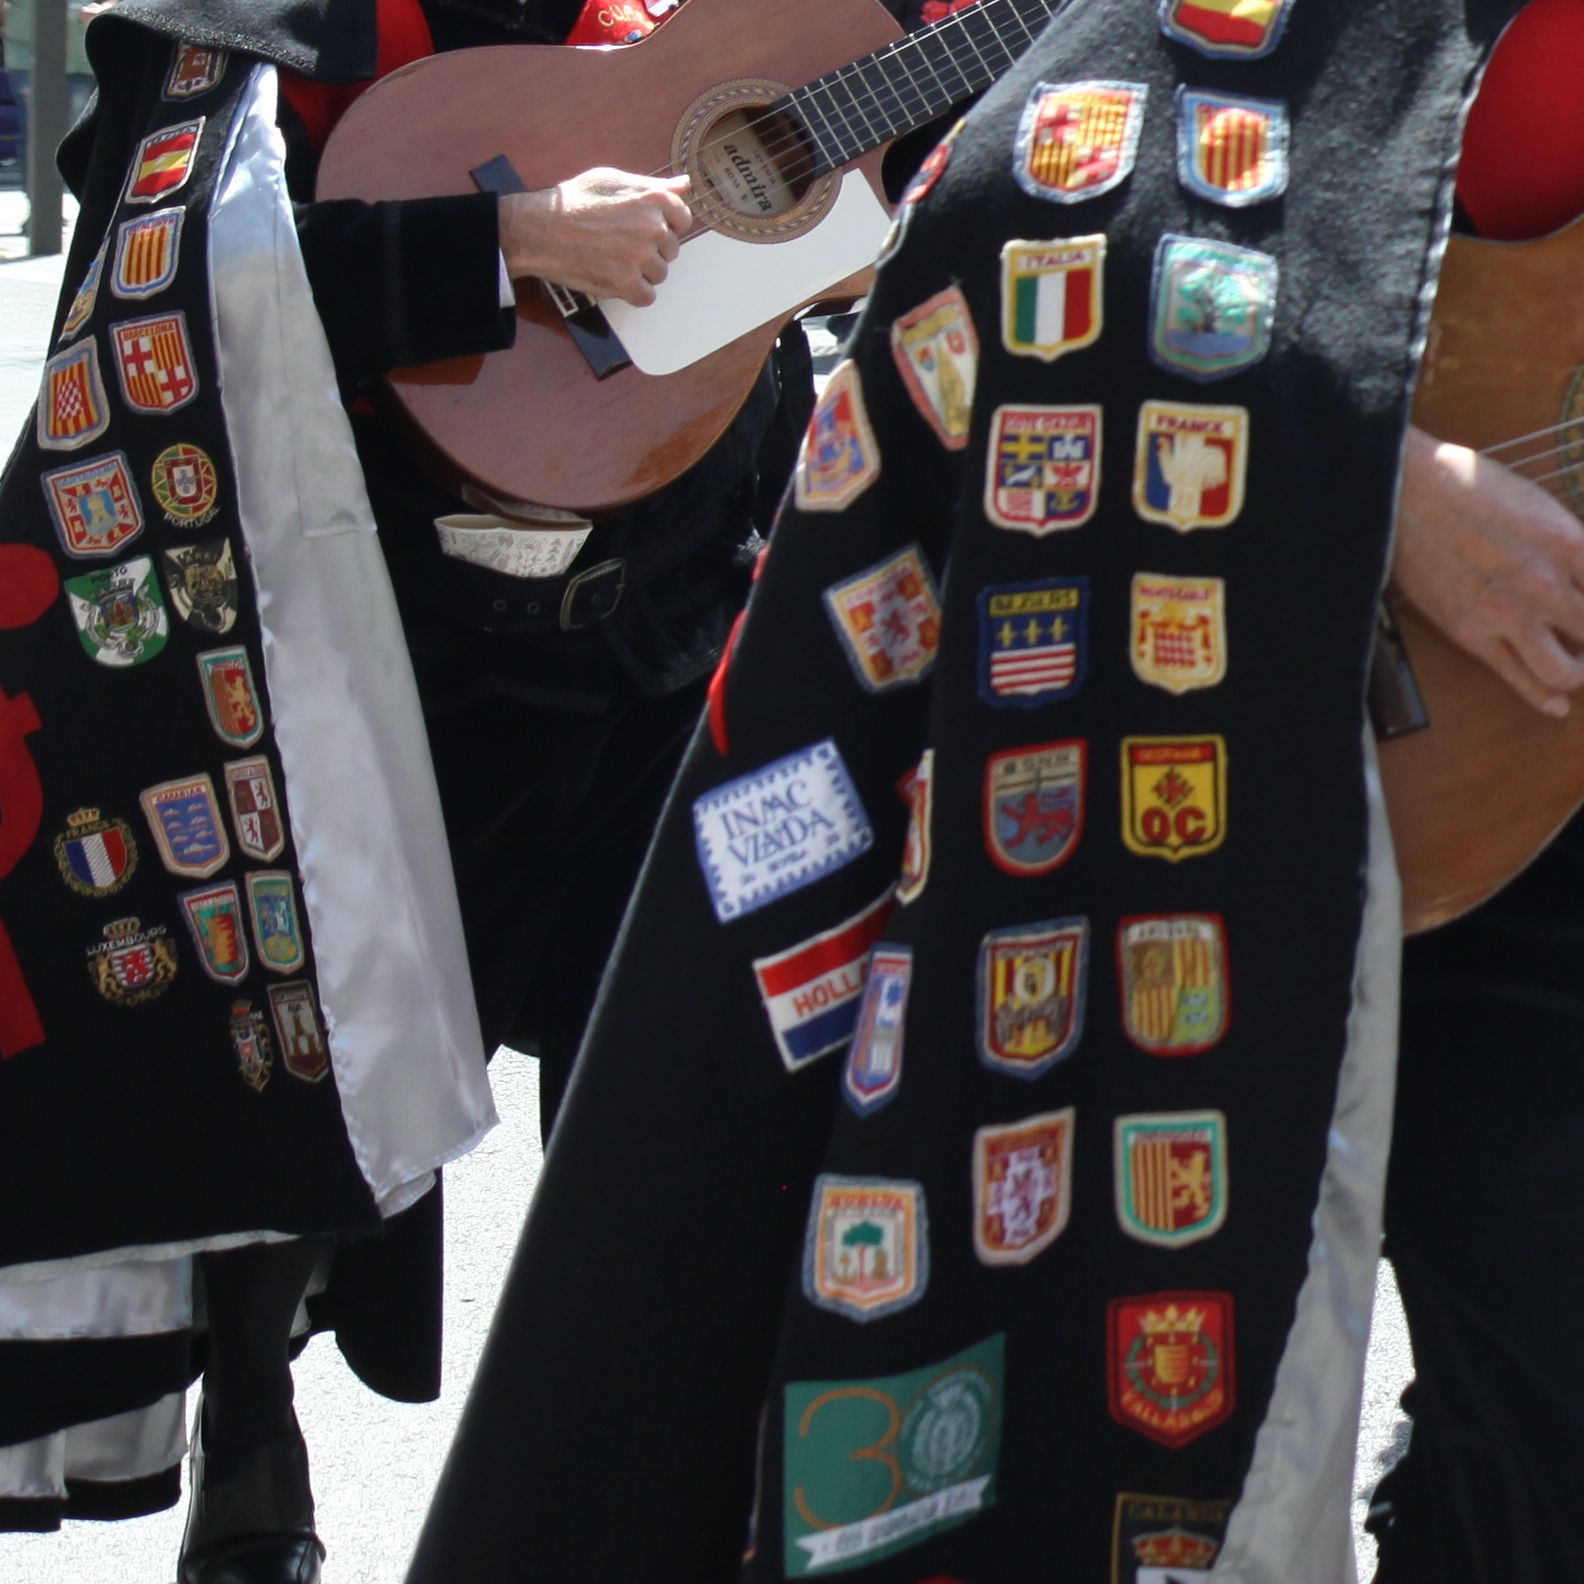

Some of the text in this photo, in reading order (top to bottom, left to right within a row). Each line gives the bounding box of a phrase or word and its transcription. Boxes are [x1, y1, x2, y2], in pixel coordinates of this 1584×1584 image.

[723, 143, 772, 212] admira
[1019, 250, 1088, 270] ITALIA
[1155, 415, 1225, 434] FRANCE
[163, 506, 221, 529] PORTUGAL
[91, 566, 128, 585] PORTO
[1142, 806, 1208, 844] OC
[86, 924, 167, 956] LUXEMBOURG
